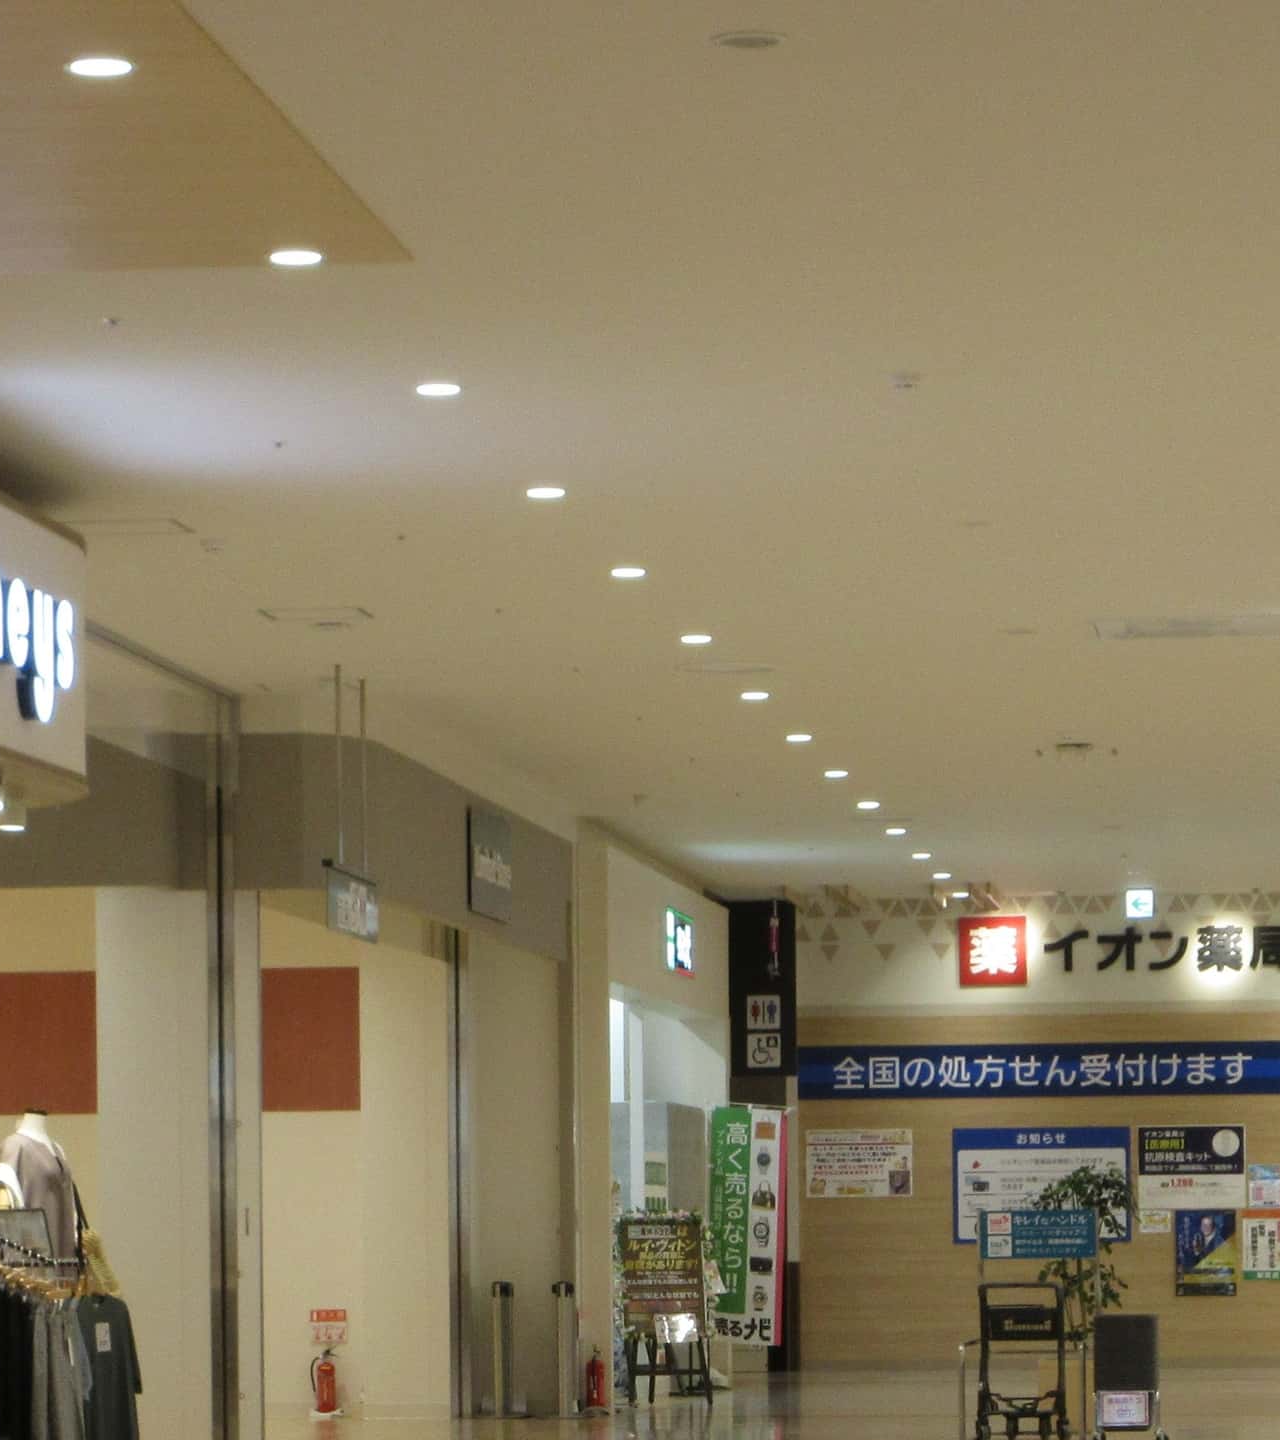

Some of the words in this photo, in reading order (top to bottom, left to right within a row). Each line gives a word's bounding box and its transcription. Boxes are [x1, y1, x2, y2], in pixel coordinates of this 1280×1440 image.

[969, 925, 1019, 975] 薬
[832, 1052, 1254, 1090] 全国の処方せん受付けます
[1015, 1132, 1067, 1146] お知らせ
